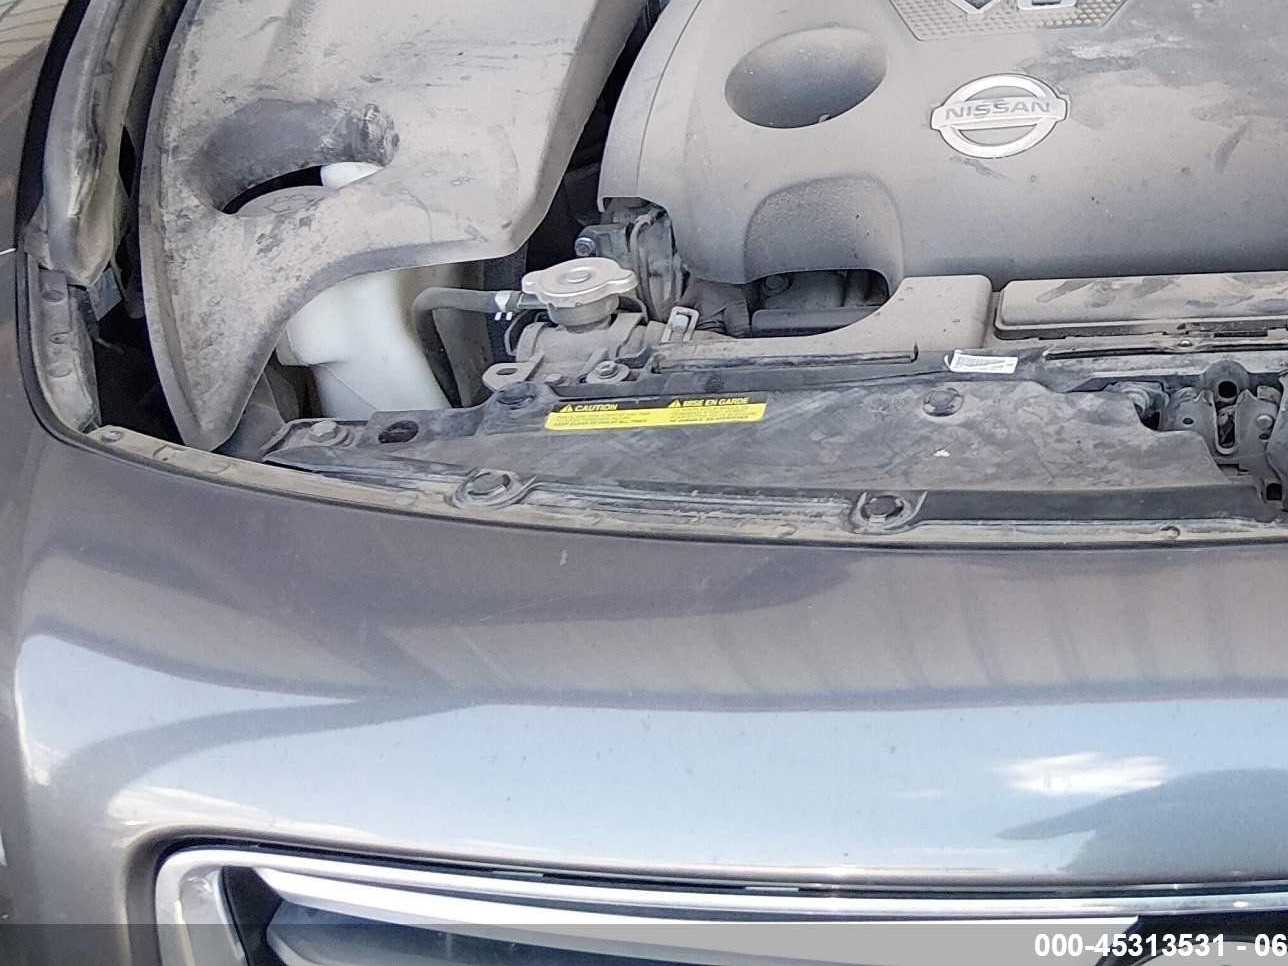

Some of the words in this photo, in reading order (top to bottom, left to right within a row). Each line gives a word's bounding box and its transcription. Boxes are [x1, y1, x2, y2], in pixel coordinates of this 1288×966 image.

[945, 100, 1050, 120] NISSAN
[682, 399, 705, 407] MISE
[704, 398, 719, 406] EN
[718, 397, 750, 406] GARDE
[574, 403, 619, 412] CAUTION
